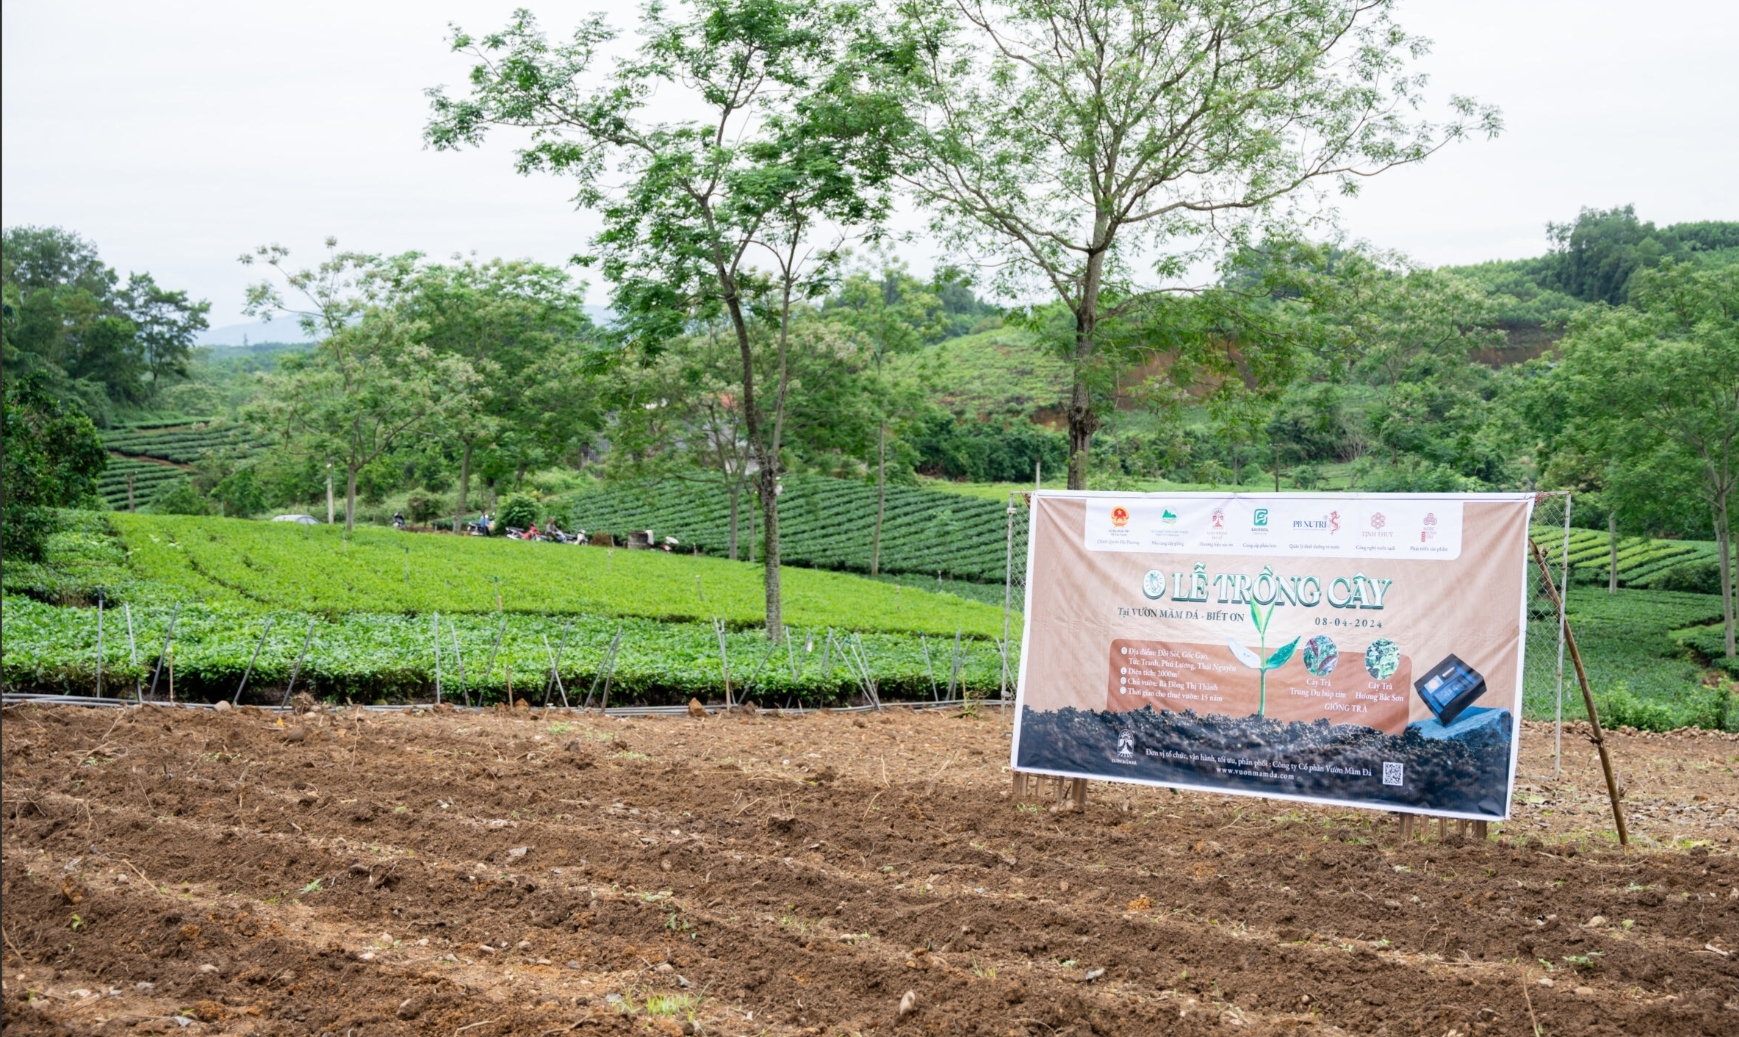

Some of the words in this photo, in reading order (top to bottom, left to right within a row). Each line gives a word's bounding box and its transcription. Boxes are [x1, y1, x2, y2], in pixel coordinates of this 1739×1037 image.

[1171, 561, 1209, 603] LỄ
[1212, 565, 1322, 608] TRỒNG
[1327, 571, 1393, 610] CÂY
[1118, 607, 1130, 618] Tại
[1132, 607, 1158, 618] VƯỜN
[1206, 610, 1228, 621] BIẾT
[1230, 612, 1245, 622] ƠN
[1314, 617, 1383, 629] 08-04-2024
[1161, 660, 1174, 668] Phú
[1197, 662, 1211, 670] Thái
[1212, 663, 1237, 673] Nguyên
[1306, 678, 1318, 688] Cây
[1320, 678, 1332, 687] Trà
[1368, 681, 1380, 691] Cây
[1381, 682, 1393, 690] Trà
[1142, 689, 1155, 698] gian
[1155, 689, 1166, 697] cho
[1290, 687, 1309, 698] Trung
[1310, 688, 1320, 697] Du
[1355, 691, 1378, 702] Hương
[1391, 694, 1404, 702] Sơn
[1324, 702, 1350, 712] GIỐNG
[1351, 704, 1368, 713] TRÀ
[1272, 760, 1290, 771] Công
[1291, 764, 1297, 772] ty
[1326, 765, 1343, 774] Vườn
[1216, 768, 1294, 780] www.vuonmamda.com
